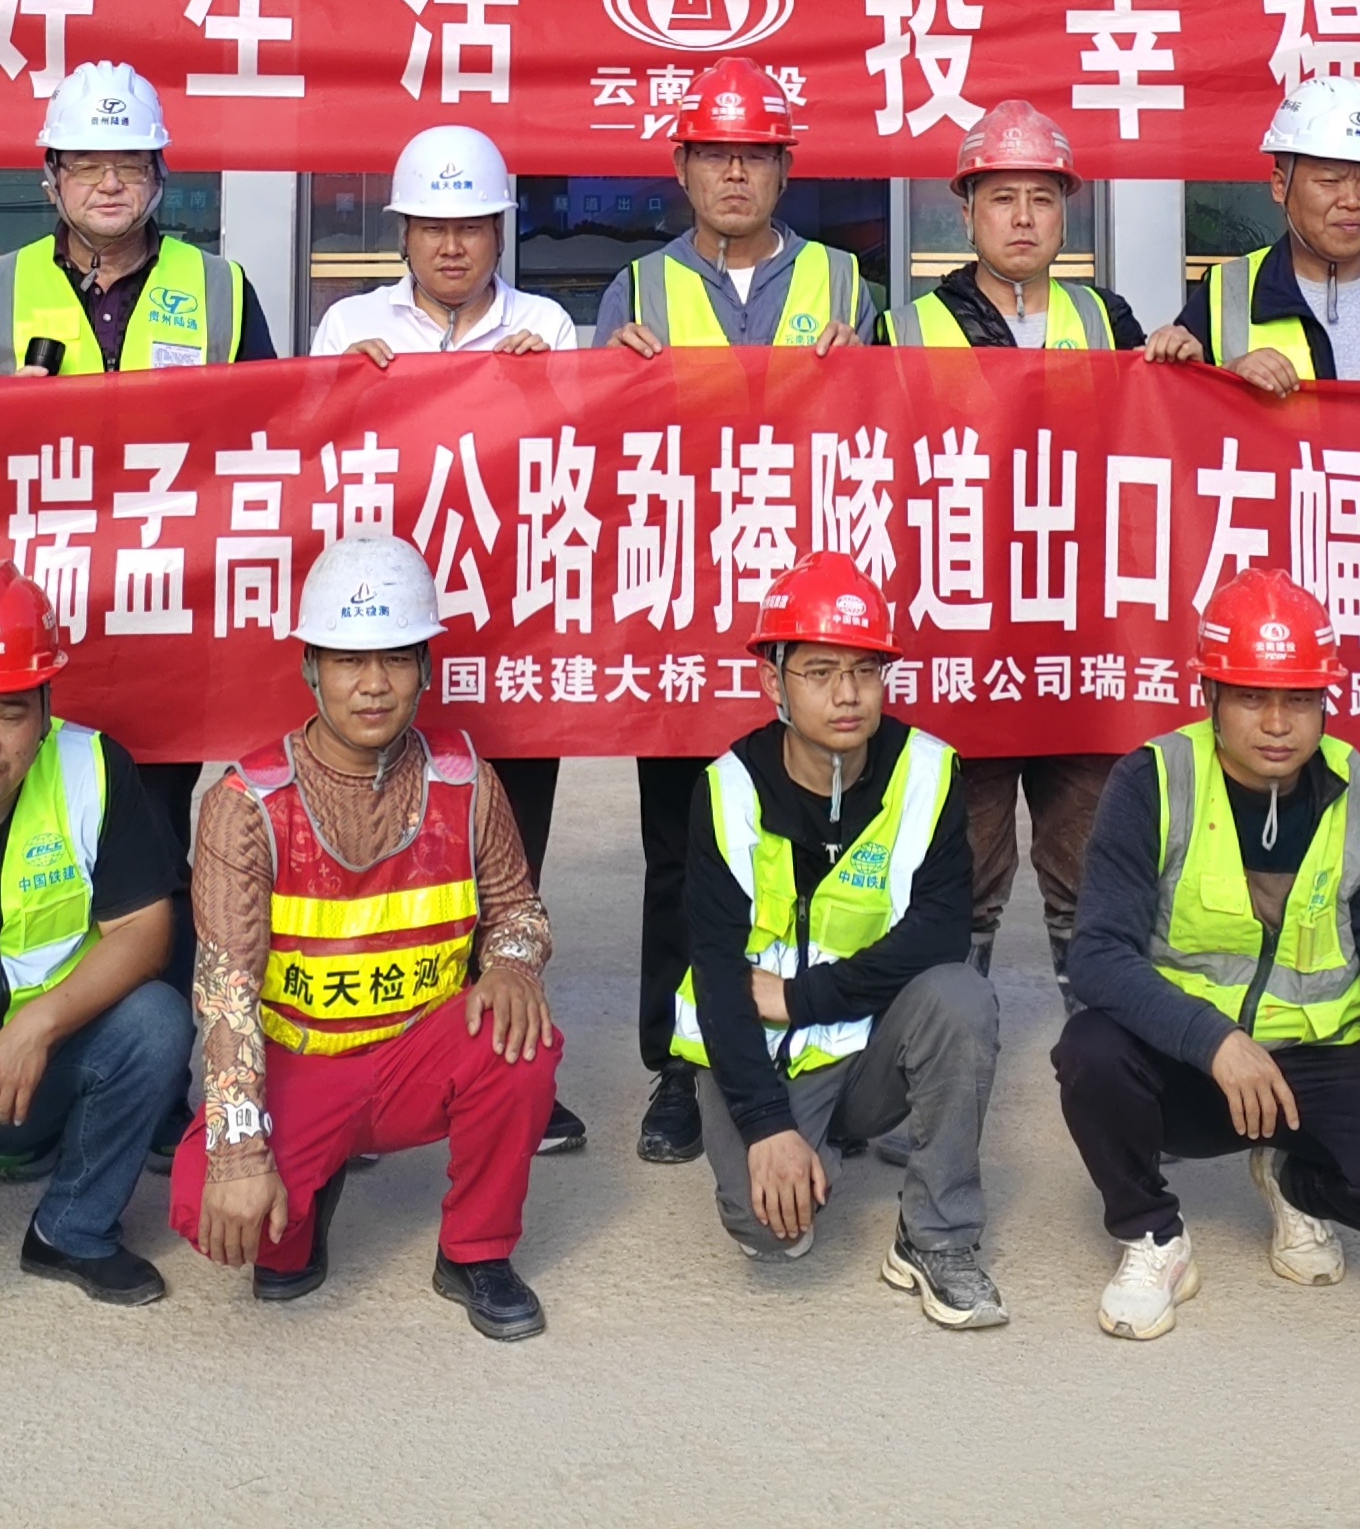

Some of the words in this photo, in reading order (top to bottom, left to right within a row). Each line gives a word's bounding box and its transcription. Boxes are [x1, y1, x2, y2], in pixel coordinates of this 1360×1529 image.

[589, 63, 809, 108] 云南投
[18, 864, 77, 892] 中国铁建
[283, 957, 441, 1008] 航天检测
